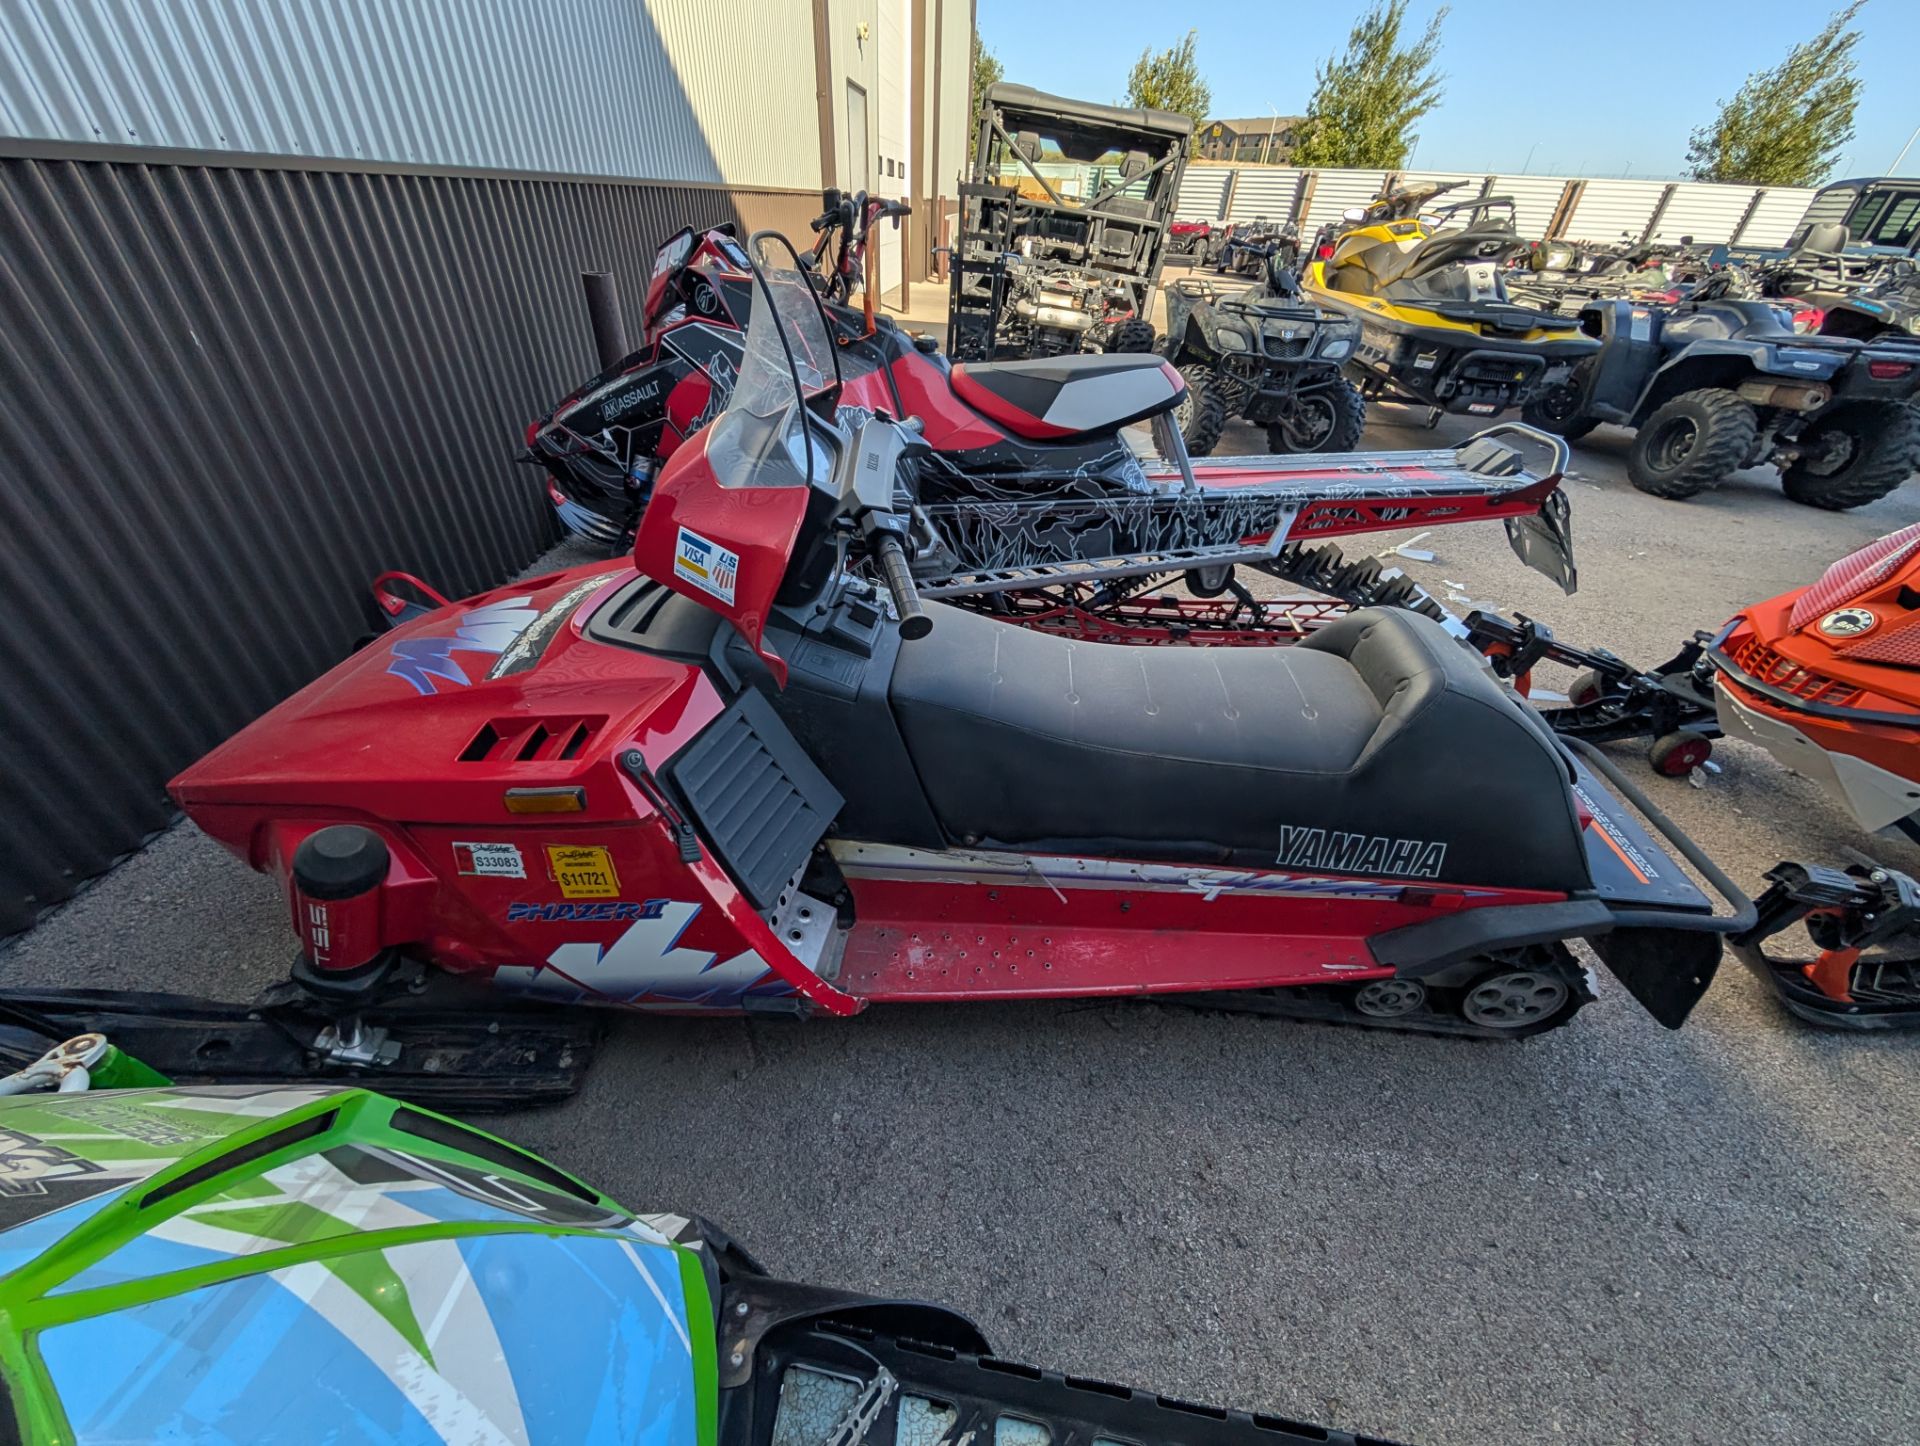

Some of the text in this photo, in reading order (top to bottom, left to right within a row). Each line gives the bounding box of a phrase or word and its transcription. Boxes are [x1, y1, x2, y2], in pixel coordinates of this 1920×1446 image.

[604, 402, 619, 418] AK
[618, 380, 660, 410] ASSAULT
[684, 544, 704, 567] VISA
[719, 552, 737, 569] US
[1836, 621, 1861, 632] BRP
[1276, 825, 1448, 878] YAMAHA
[475, 857, 519, 868] S33083
[561, 872, 609, 886] S11721
[507, 902, 643, 921] PHAZER
